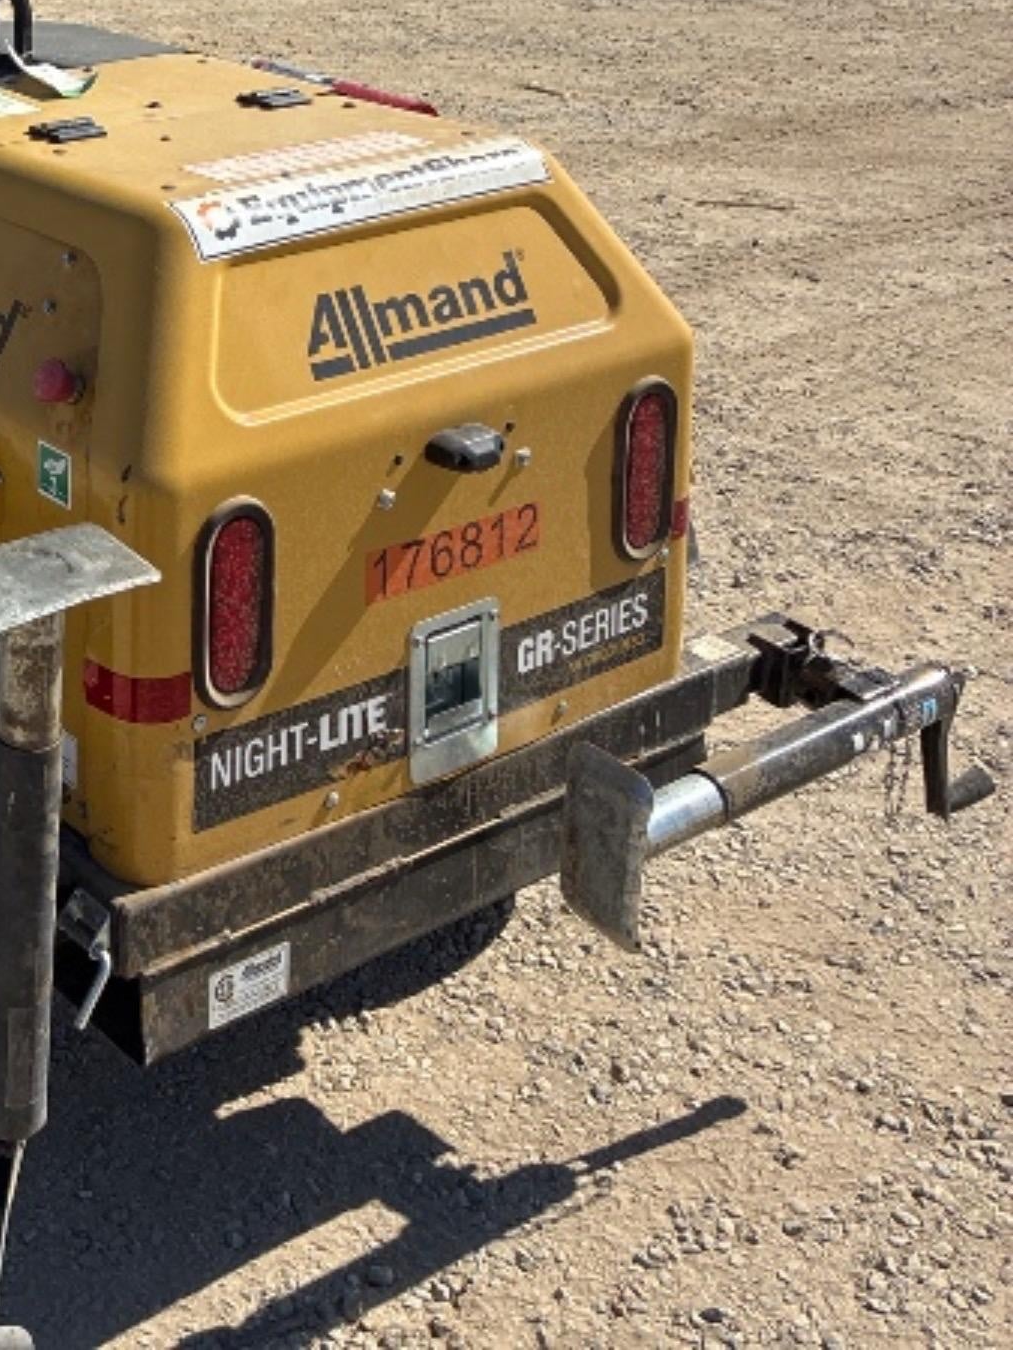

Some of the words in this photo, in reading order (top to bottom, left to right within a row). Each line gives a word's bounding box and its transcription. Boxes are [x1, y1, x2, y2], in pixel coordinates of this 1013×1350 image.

[307, 250, 529, 370] Allmand
[373, 503, 538, 597] 176812
[516, 593, 649, 675] GR-SERIES
[210, 694, 389, 791] NIGHT-LITE
